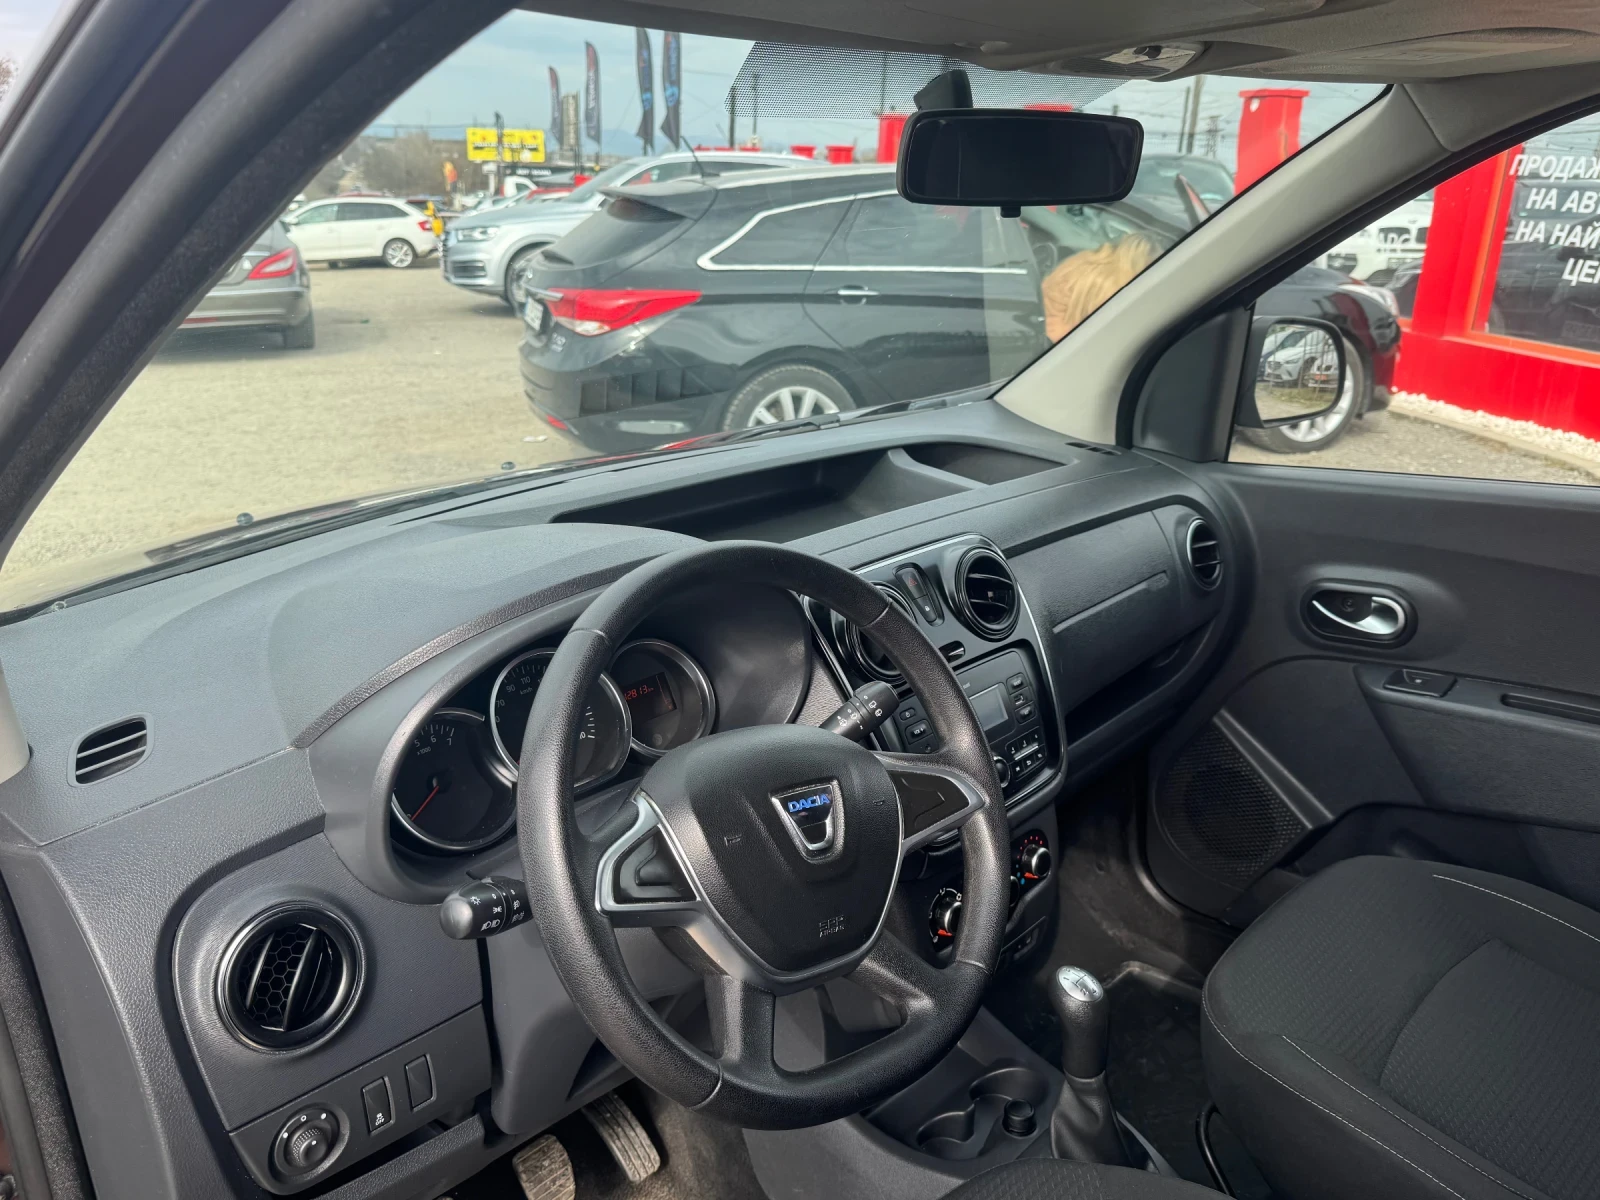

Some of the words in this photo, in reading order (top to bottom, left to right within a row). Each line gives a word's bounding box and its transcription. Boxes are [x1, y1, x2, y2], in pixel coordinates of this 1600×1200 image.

[1525, 187, 1558, 210] НА
[1560, 190, 1600, 214] АВ
[1514, 220, 1546, 243] НА
[430, 734, 437, 743] 6
[446, 737, 452, 746] 7
[788, 794, 831, 812] DACIA
